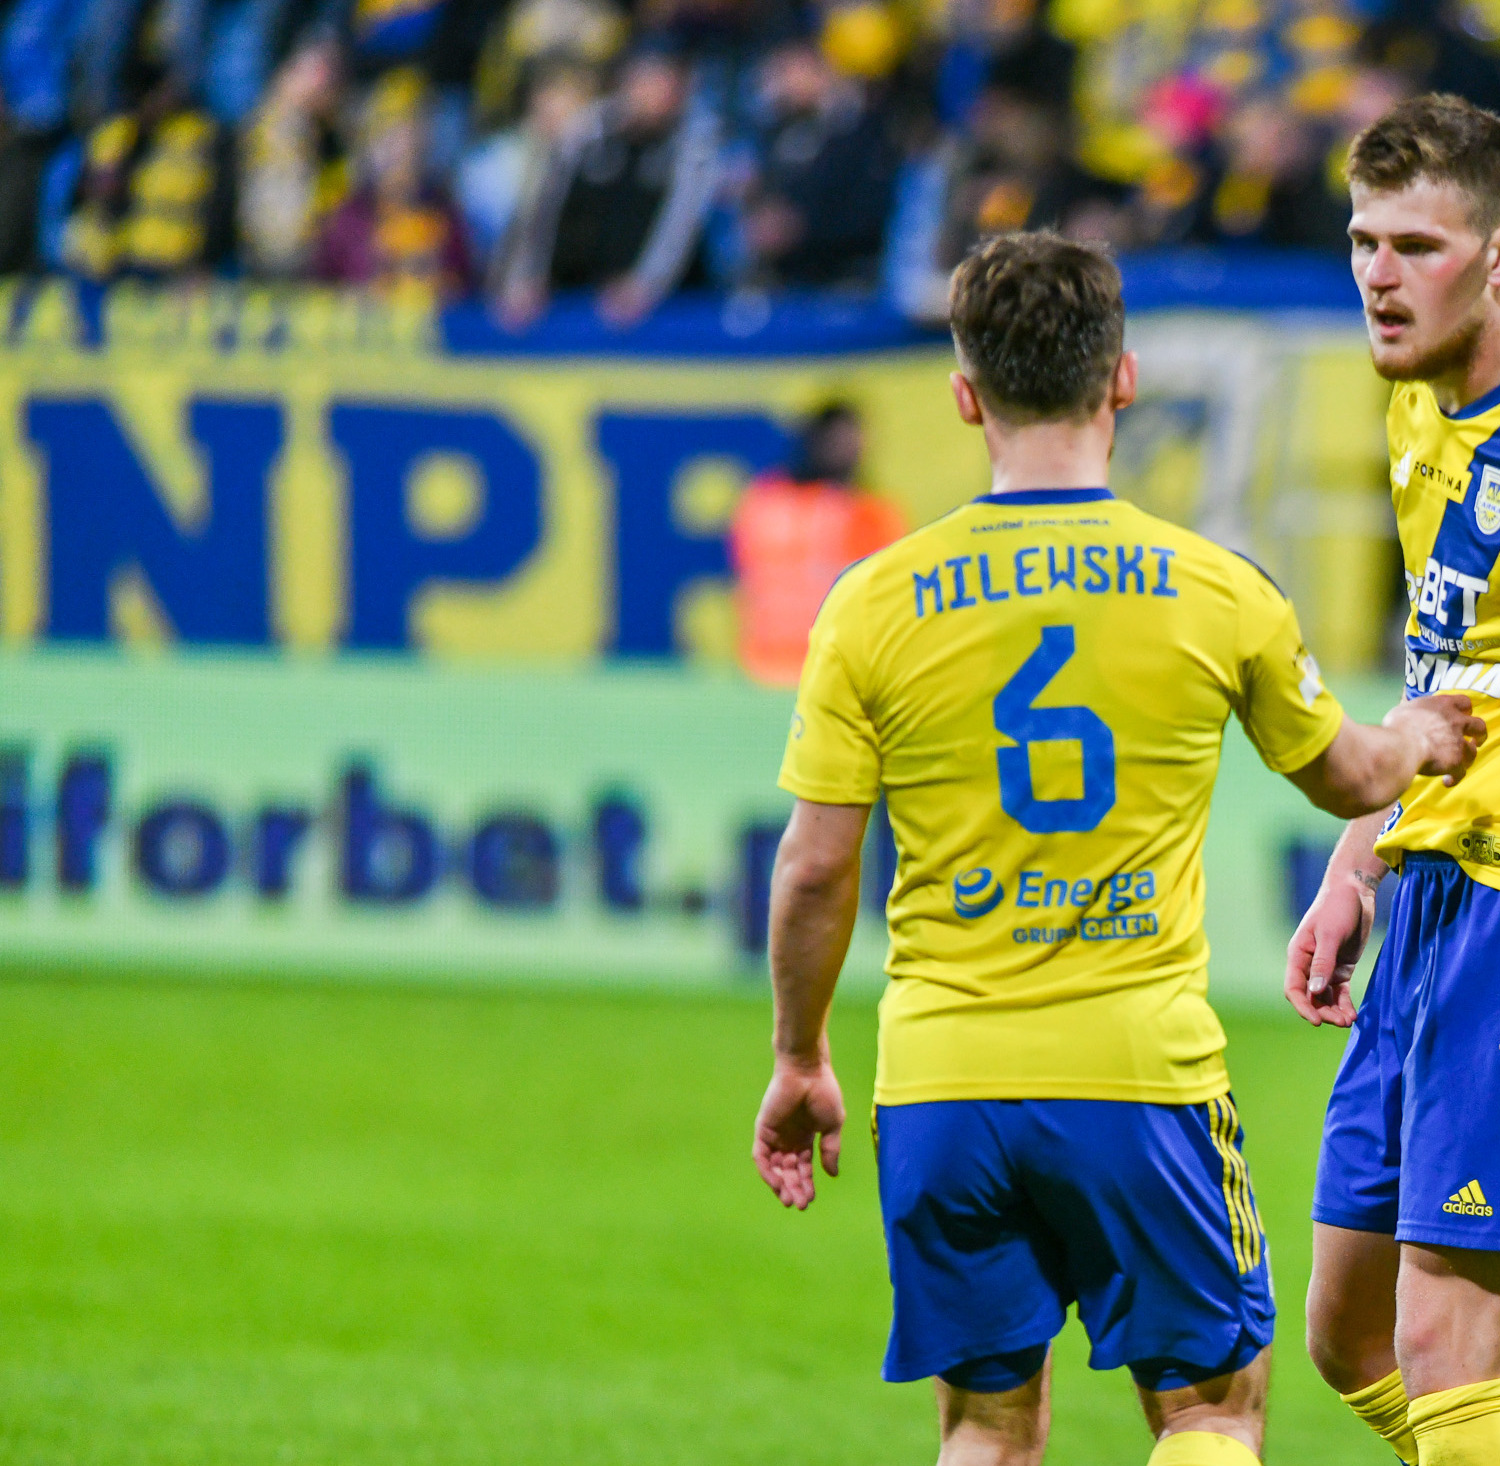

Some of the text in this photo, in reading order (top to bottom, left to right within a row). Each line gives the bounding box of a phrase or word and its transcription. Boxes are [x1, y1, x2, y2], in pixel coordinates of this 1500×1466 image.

[912, 545, 1178, 617] MILEWSKI
[993, 625, 1116, 834] 6
[1015, 871, 1155, 912] Energa
[1083, 915, 1156, 938] ORLEN
[1442, 1201, 1493, 1217] adidas
